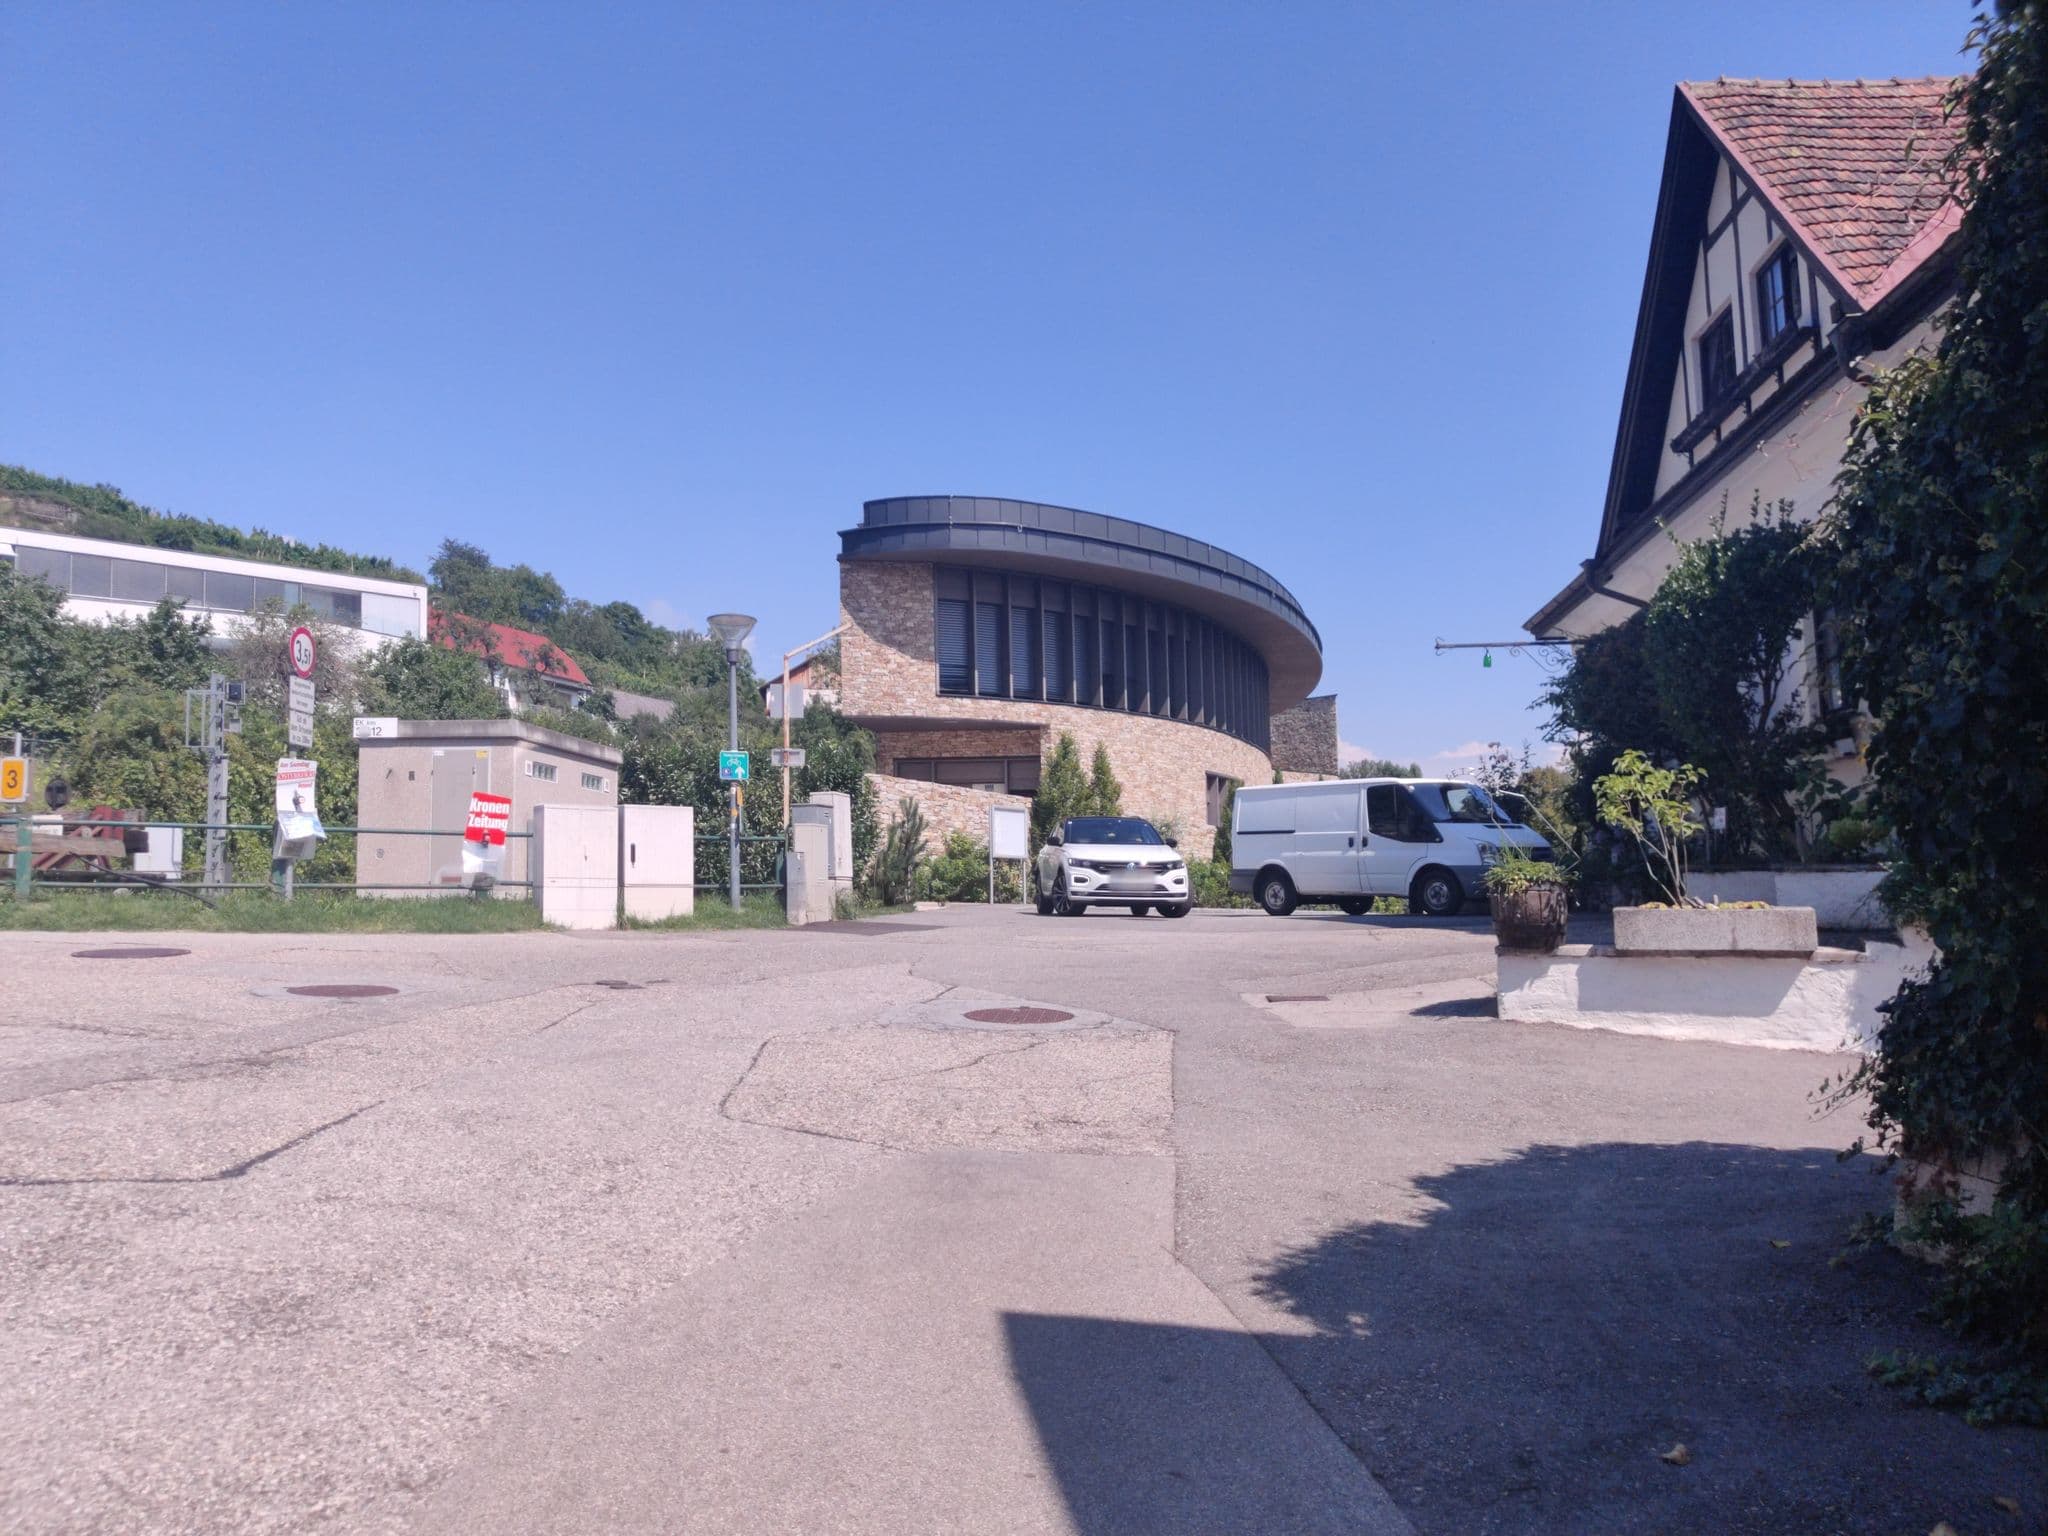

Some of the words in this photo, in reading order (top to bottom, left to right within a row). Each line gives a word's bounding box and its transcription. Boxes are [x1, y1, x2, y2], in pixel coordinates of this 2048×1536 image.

[7, 769, 18, 789] 3
[469, 797, 510, 814] Kronen
[467, 813, 508, 832] Zeitung
